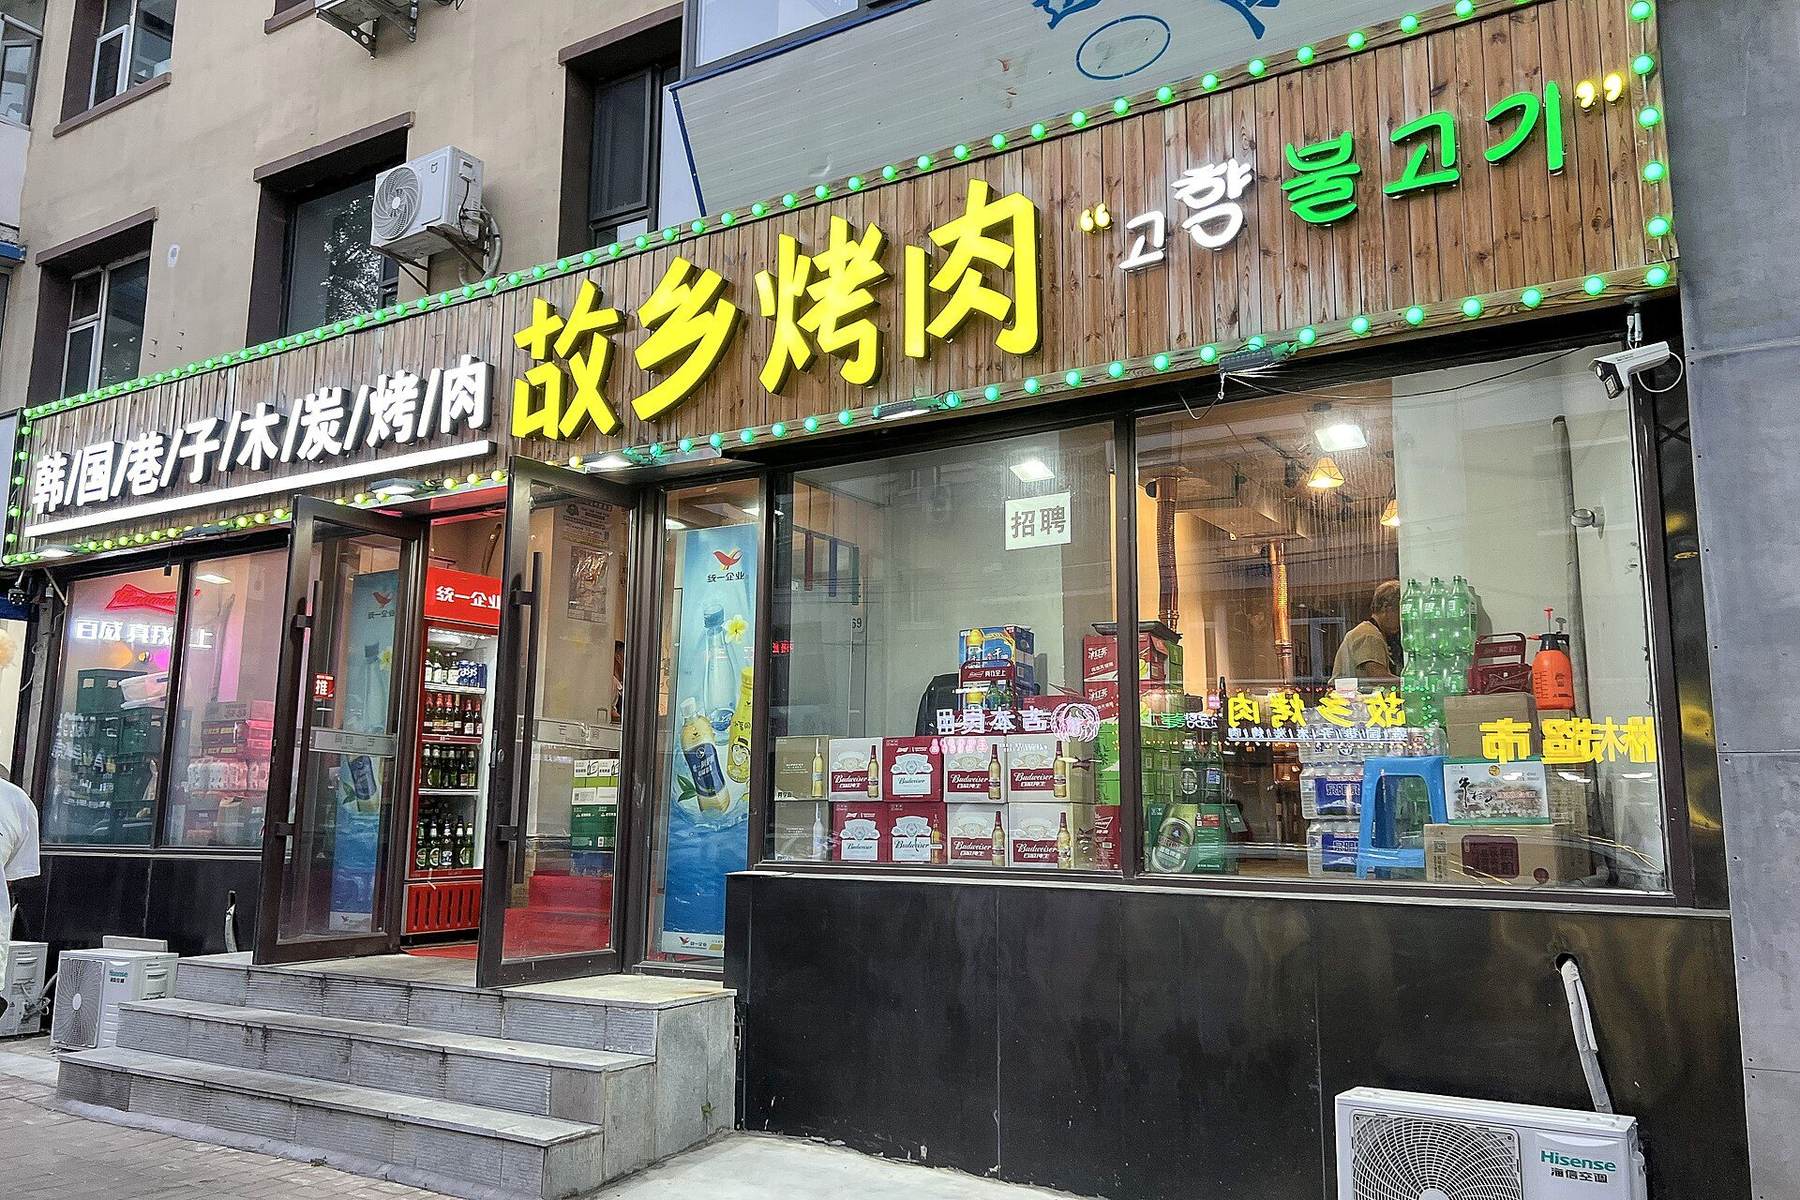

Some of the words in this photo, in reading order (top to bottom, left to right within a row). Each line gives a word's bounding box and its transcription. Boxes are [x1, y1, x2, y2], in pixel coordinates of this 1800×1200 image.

[512, 178, 1041, 440] 故乡烤肉
[1010, 505, 1067, 539] 招聘
[707, 572, 745, 583] 统一企业
[315, 679, 328, 695] 推
[950, 773, 988, 783] Budweiser
[1013, 772, 1053, 781] Budweiser
[953, 840, 991, 850] Budweiser
[1016, 843, 1057, 853] Budweiser
[1541, 1150, 1617, 1172] Hisense
[1551, 1167, 1608, 1184] 海信空调
